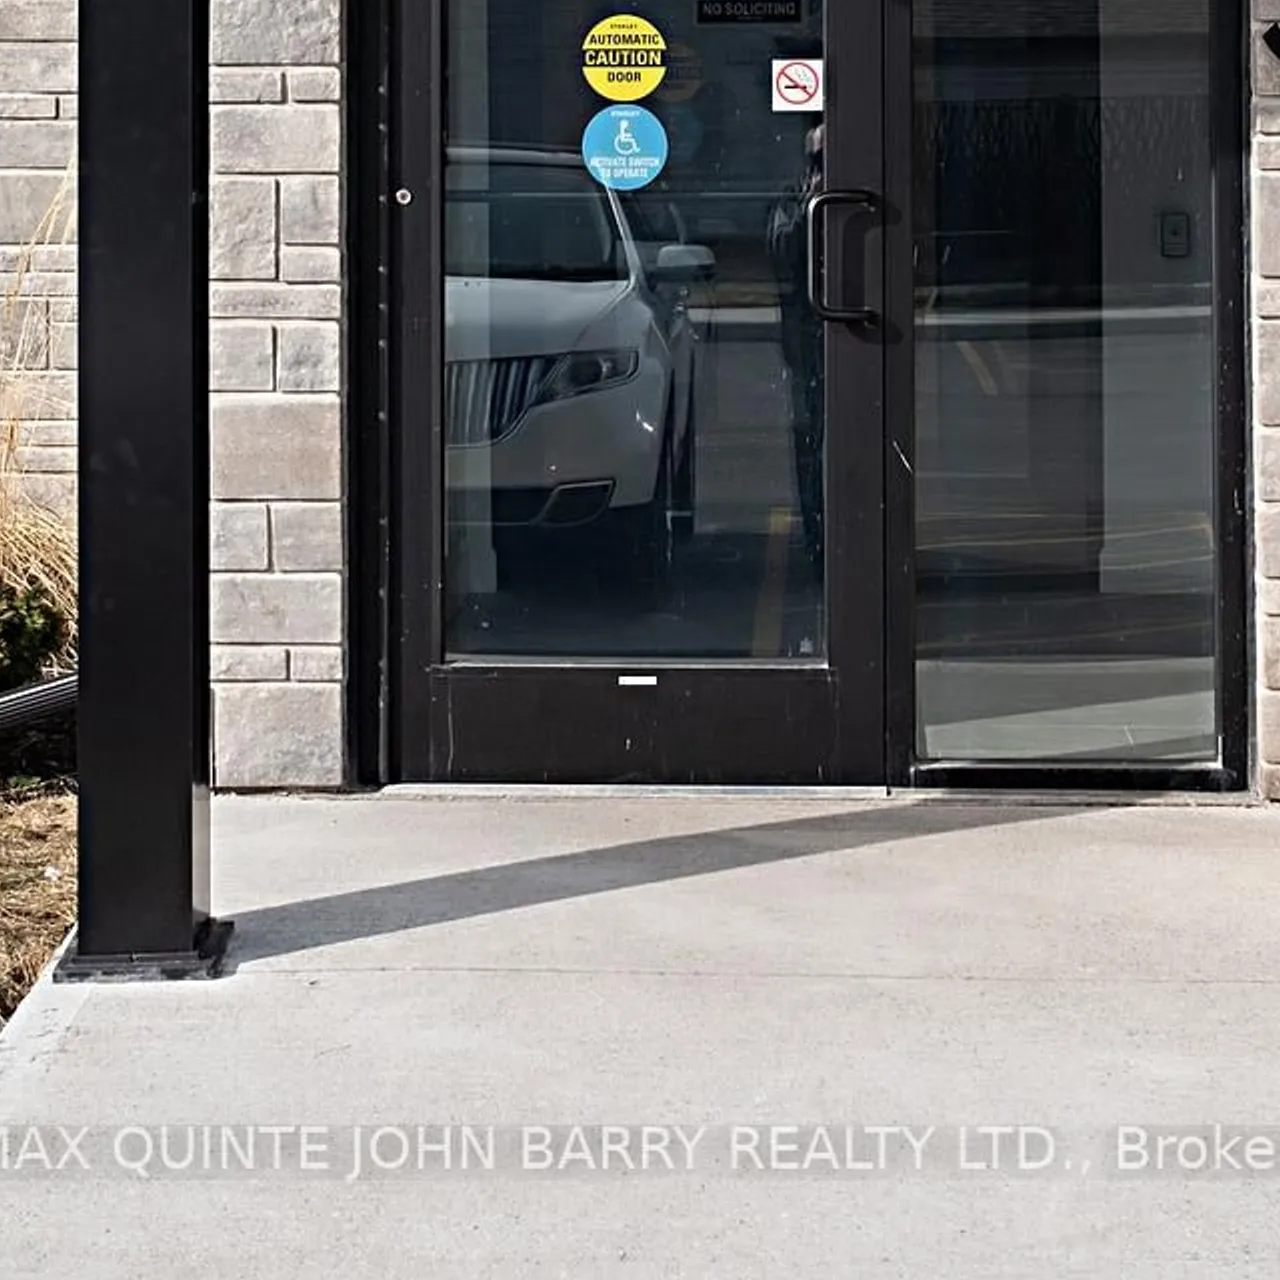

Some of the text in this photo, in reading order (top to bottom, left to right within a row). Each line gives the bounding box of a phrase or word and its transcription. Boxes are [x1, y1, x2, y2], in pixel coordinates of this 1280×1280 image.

[703, 2, 795, 15] NO SOLICITING
[589, 33, 659, 45] AUTOMATIC
[585, 49, 662, 65] CAUTION
[608, 72, 641, 82] DOOR
